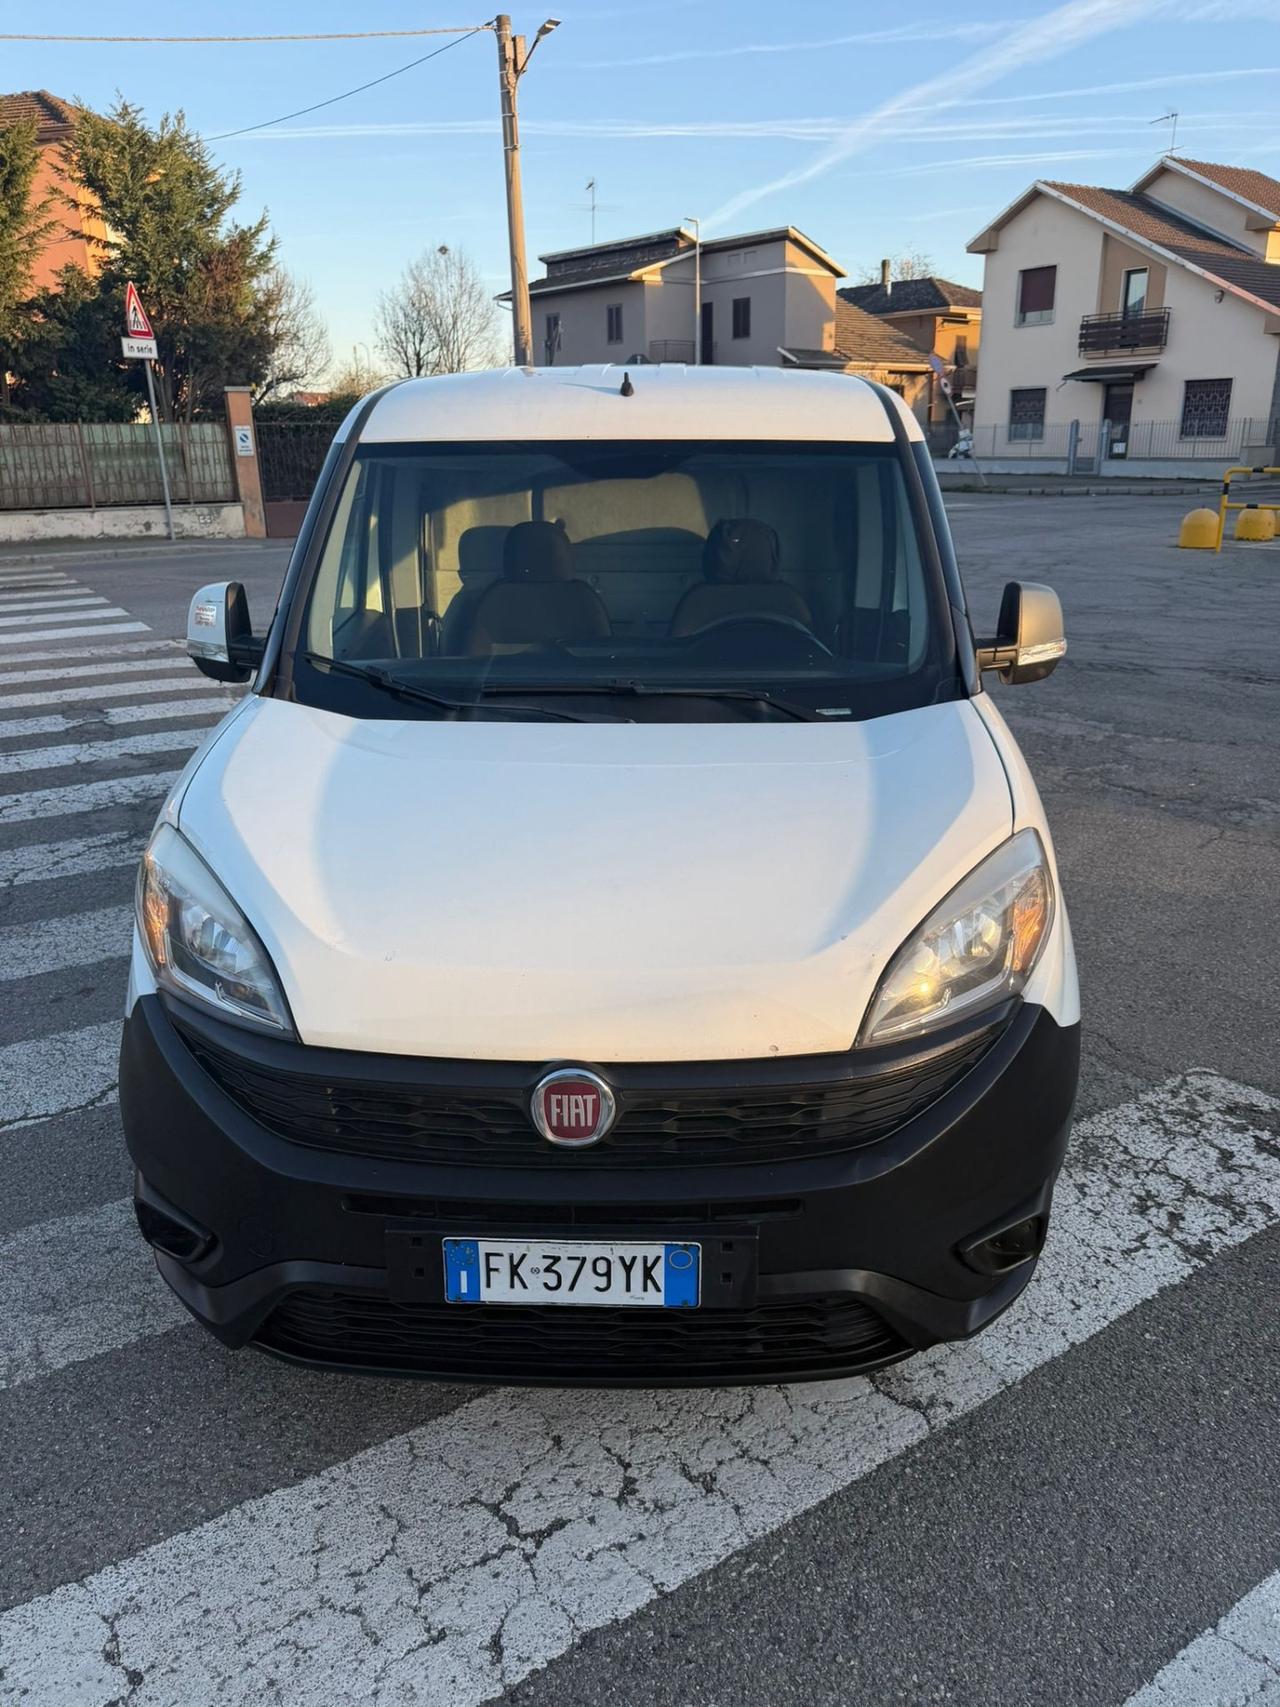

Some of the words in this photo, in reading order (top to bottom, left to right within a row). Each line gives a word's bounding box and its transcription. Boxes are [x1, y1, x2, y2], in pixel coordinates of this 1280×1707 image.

[127, 342, 135, 352] in
[136, 344, 153, 354] serie
[550, 1094, 597, 1127] FIAT
